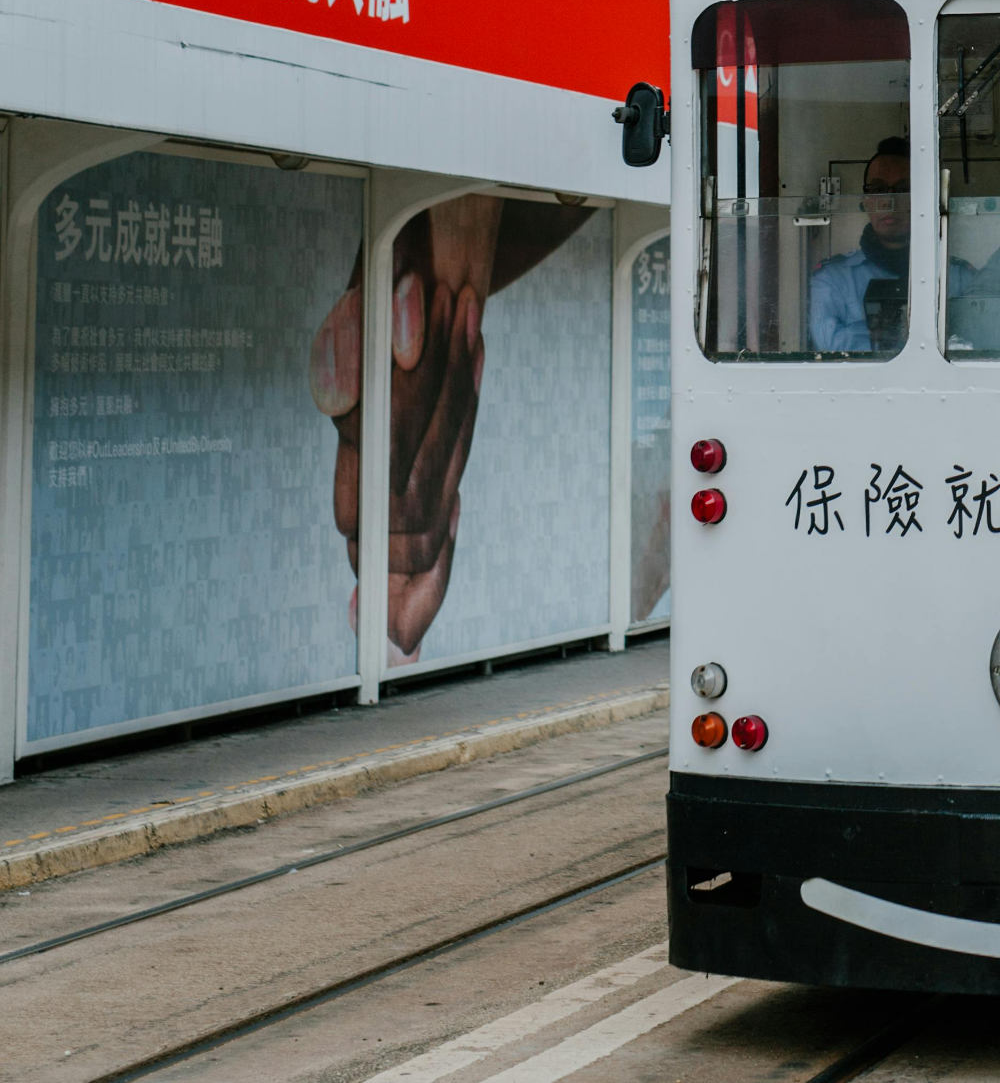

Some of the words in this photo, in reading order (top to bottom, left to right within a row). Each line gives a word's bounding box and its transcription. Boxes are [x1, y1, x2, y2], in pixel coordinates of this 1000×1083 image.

[54, 193, 222, 269] 多元成就共融
[638, 250, 671, 295] 多元
